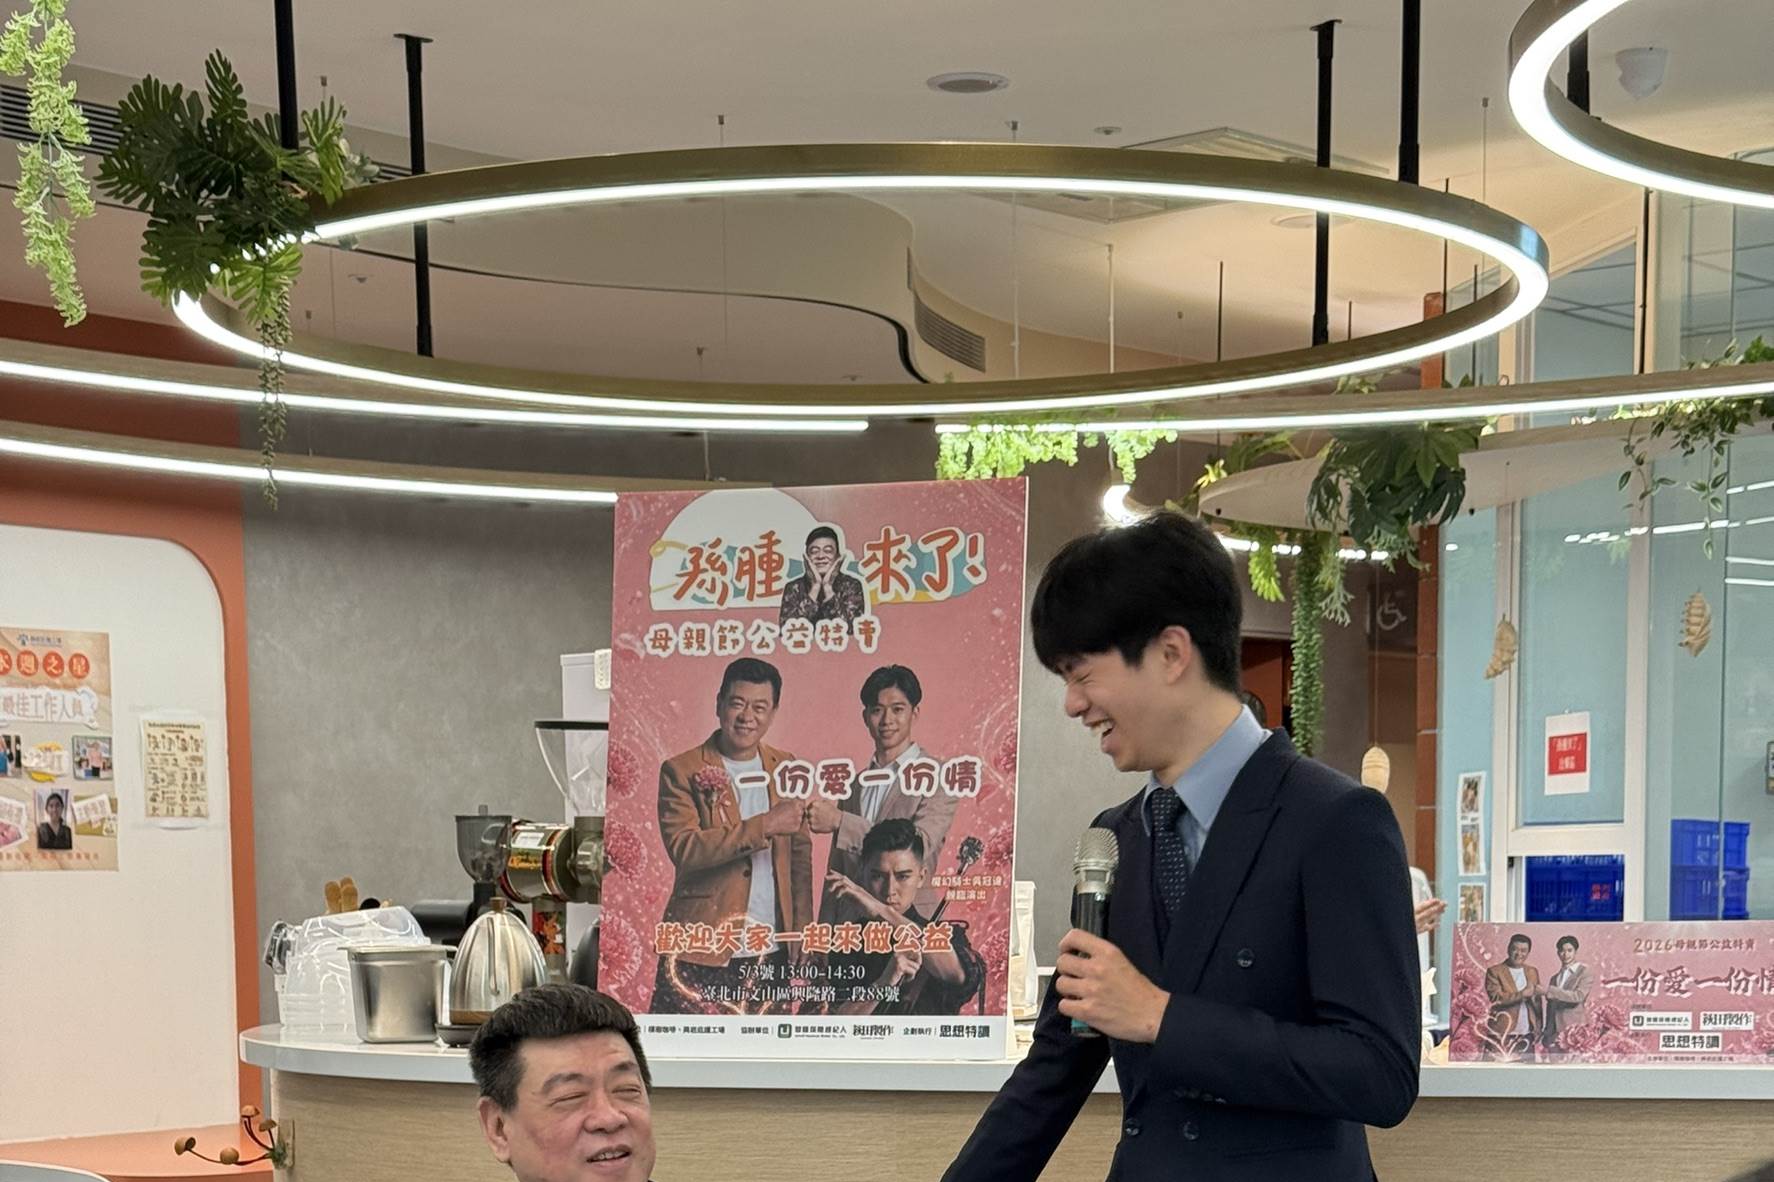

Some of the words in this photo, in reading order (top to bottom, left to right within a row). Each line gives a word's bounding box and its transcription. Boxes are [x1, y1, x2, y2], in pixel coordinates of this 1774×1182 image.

[650, 616, 879, 651] 母親節公益特賣
[737, 759, 980, 798] 一份愛一份情
[655, 922, 953, 953] 歡迎大家一起來做公益
[738, 963, 774, 981] 5/3號
[780, 965, 866, 980] 13:00-14:30
